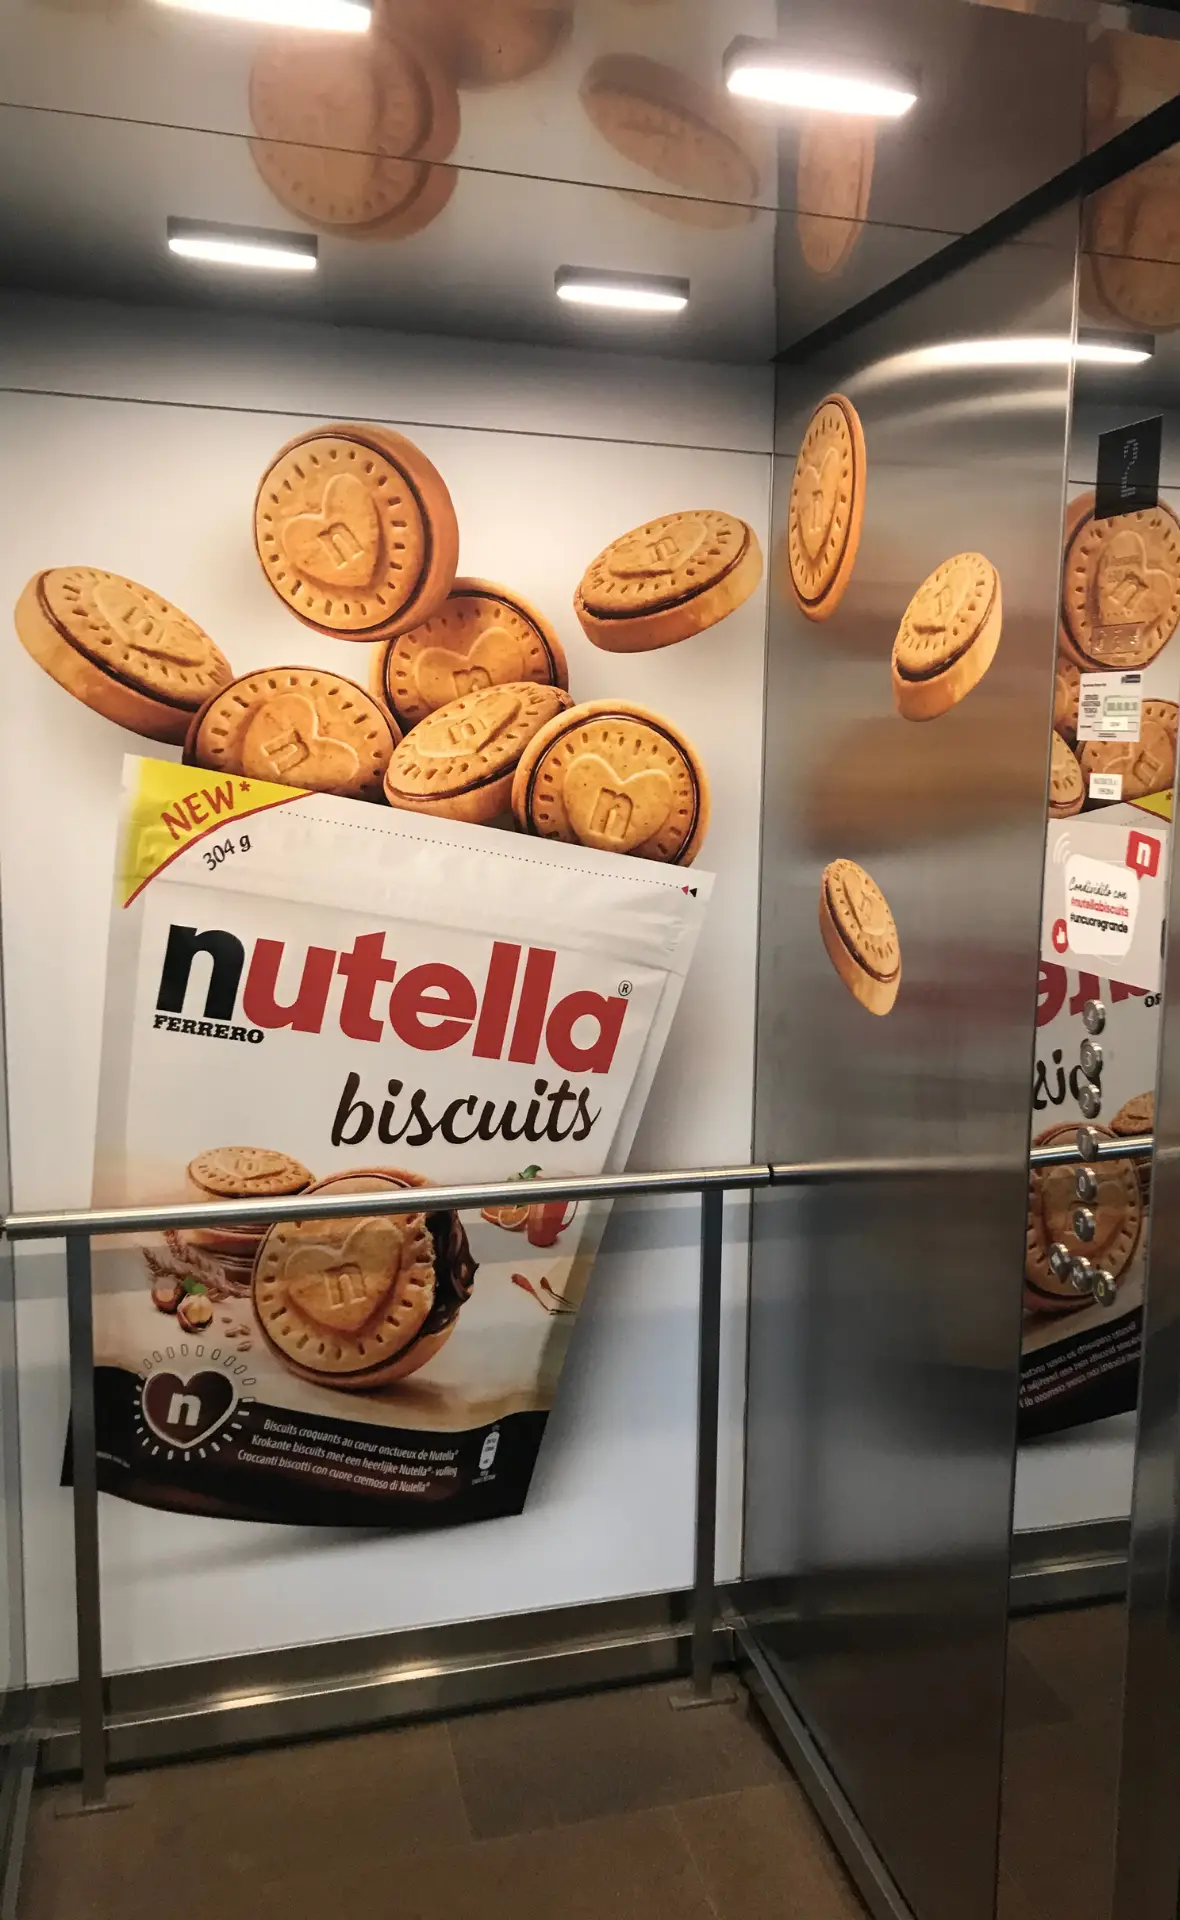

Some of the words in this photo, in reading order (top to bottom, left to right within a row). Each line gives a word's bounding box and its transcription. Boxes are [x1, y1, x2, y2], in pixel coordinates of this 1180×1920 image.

[202, 838, 235, 871] 304
[237, 832, 253, 853] g
[1137, 839, 1150, 867] n
[1070, 912, 1128, 933] #uncuoregrande
[152, 1014, 266, 1045] FERRERO
[331, 1071, 602, 1147] biscuits
[166, 1391, 201, 1427] n
[251, 1434, 292, 1451] Krokante
[291, 1441, 326, 1458] biscuits
[325, 1451, 345, 1463] met
[345, 1457, 361, 1467] een
[361, 1457, 398, 1474] heerlijke
[263, 1418, 298, 1435] Biscuits
[298, 1427, 342, 1445] croquants
[341, 1437, 354, 1448] au
[354, 1440, 378, 1453] coeur
[378, 1445, 417, 1460] onctueux
[418, 1449, 428, 1461] de
[237, 1449, 279, 1466] Croccanti
[278, 1456, 312, 1472] biscotti
[311, 1464, 328, 1476] con
[328, 1469, 352, 1481] cuore
[353, 1474, 389, 1490] cremoso
[389, 1480, 398, 1491] di
